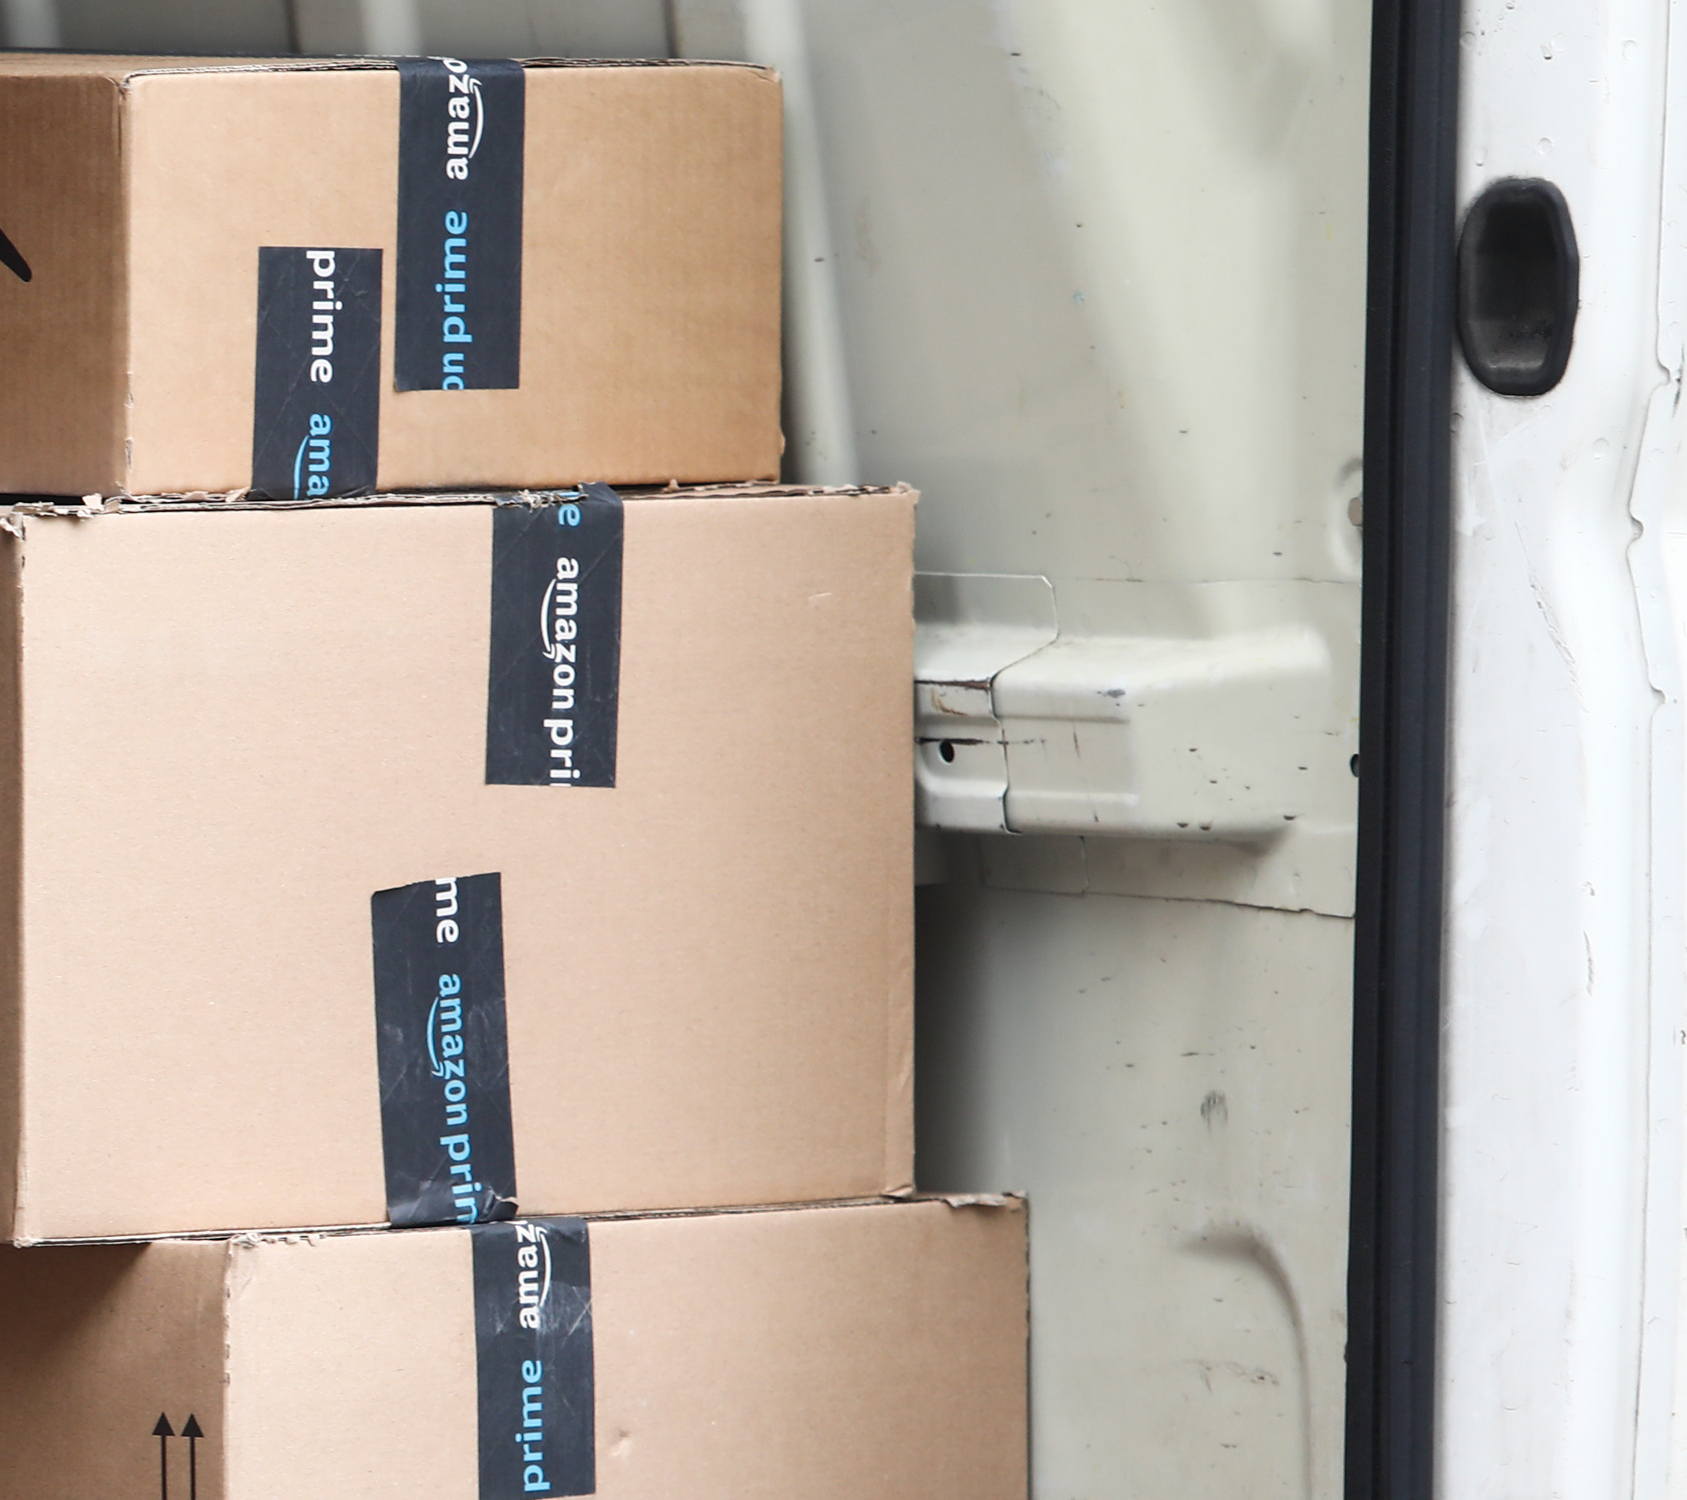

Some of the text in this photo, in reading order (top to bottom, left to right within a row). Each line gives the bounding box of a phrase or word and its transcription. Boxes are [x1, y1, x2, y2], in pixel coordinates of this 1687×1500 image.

[446, 57, 471, 181] amazo
[435, 210, 473, 343] prime
[306, 250, 343, 496] prime ama
[551, 557, 580, 711] amazon
[543, 718, 581, 788] pri
[437, 973, 469, 1126] amazon
[514, 1220, 551, 1492] prime amaz
